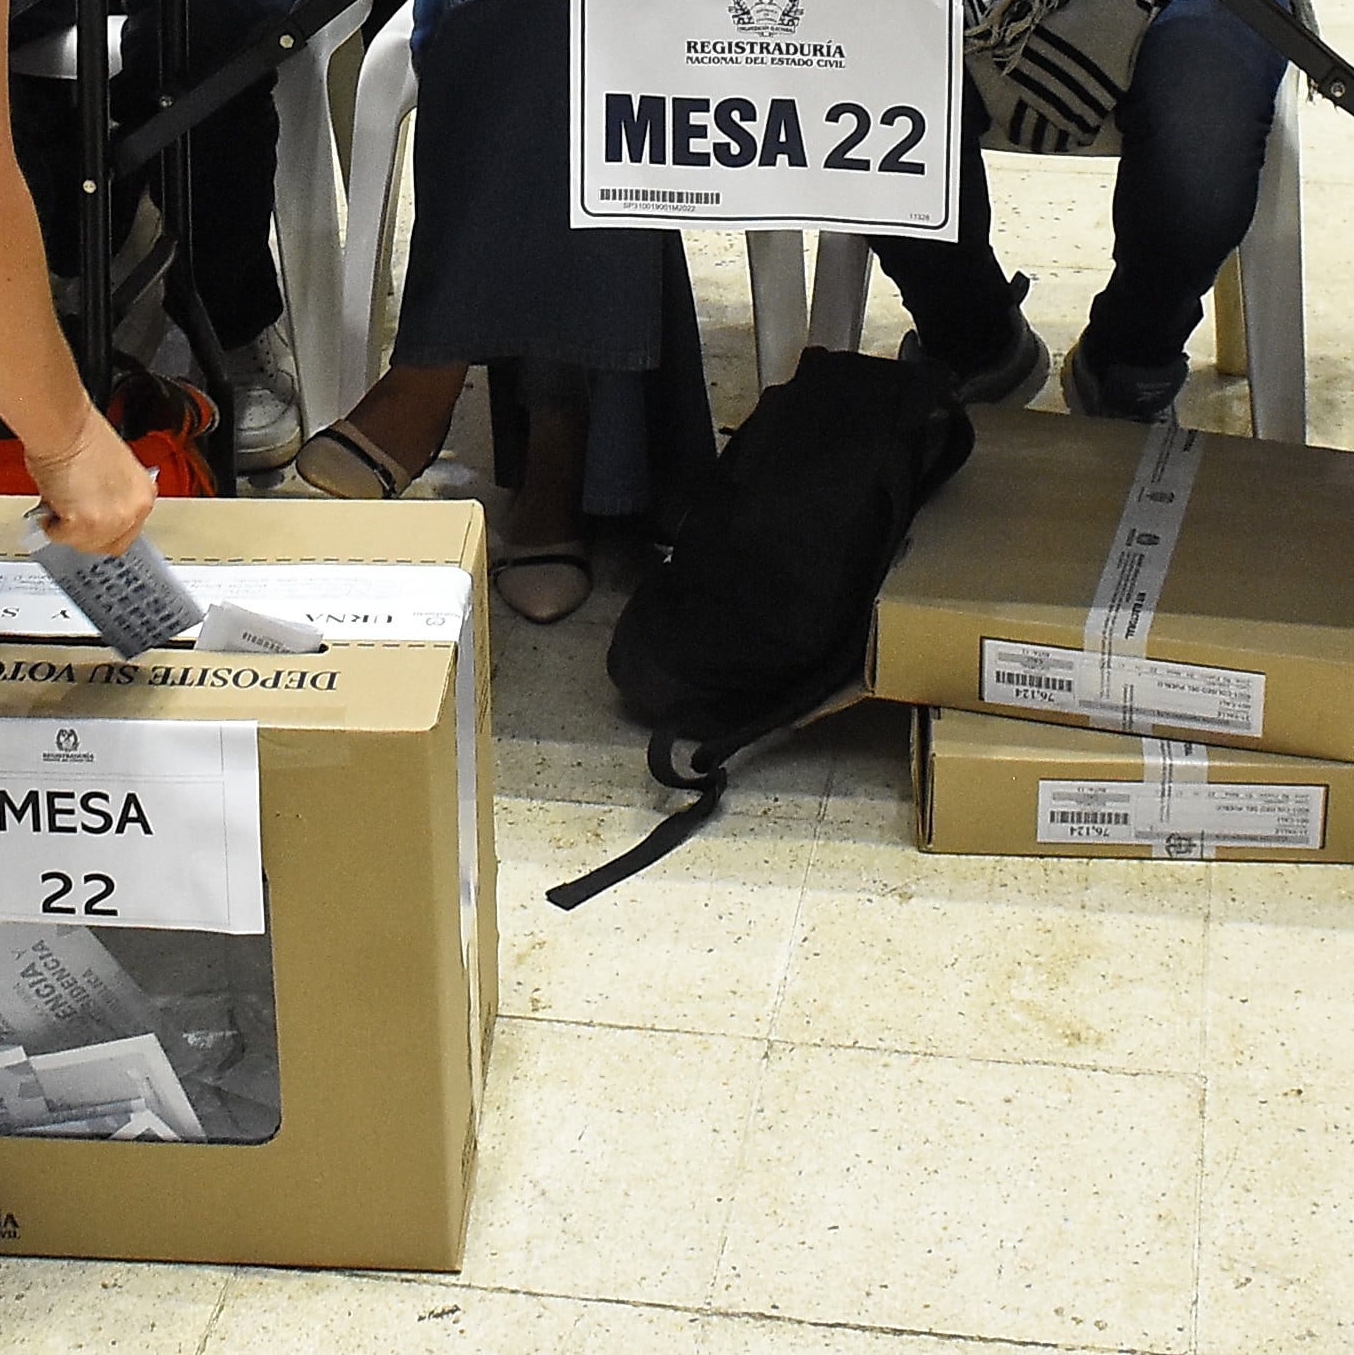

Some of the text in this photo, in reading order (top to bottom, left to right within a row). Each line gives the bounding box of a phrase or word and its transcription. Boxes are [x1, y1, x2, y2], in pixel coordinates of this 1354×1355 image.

[686, 40, 845, 59] REGISTRADURÍA
[686, 56, 845, 68] NACIONAL DEL ESTADO CIVIL
[605, 93, 926, 175] MESA 22
[304, 611, 393, 625] URNA
[89, 662, 135, 686] SU
[150, 665, 340, 692] DEPOSITE
[1014, 688, 1055, 703] 76,124
[1069, 825, 1111, 838] 76,124
[40, 872, 119, 917] 22
